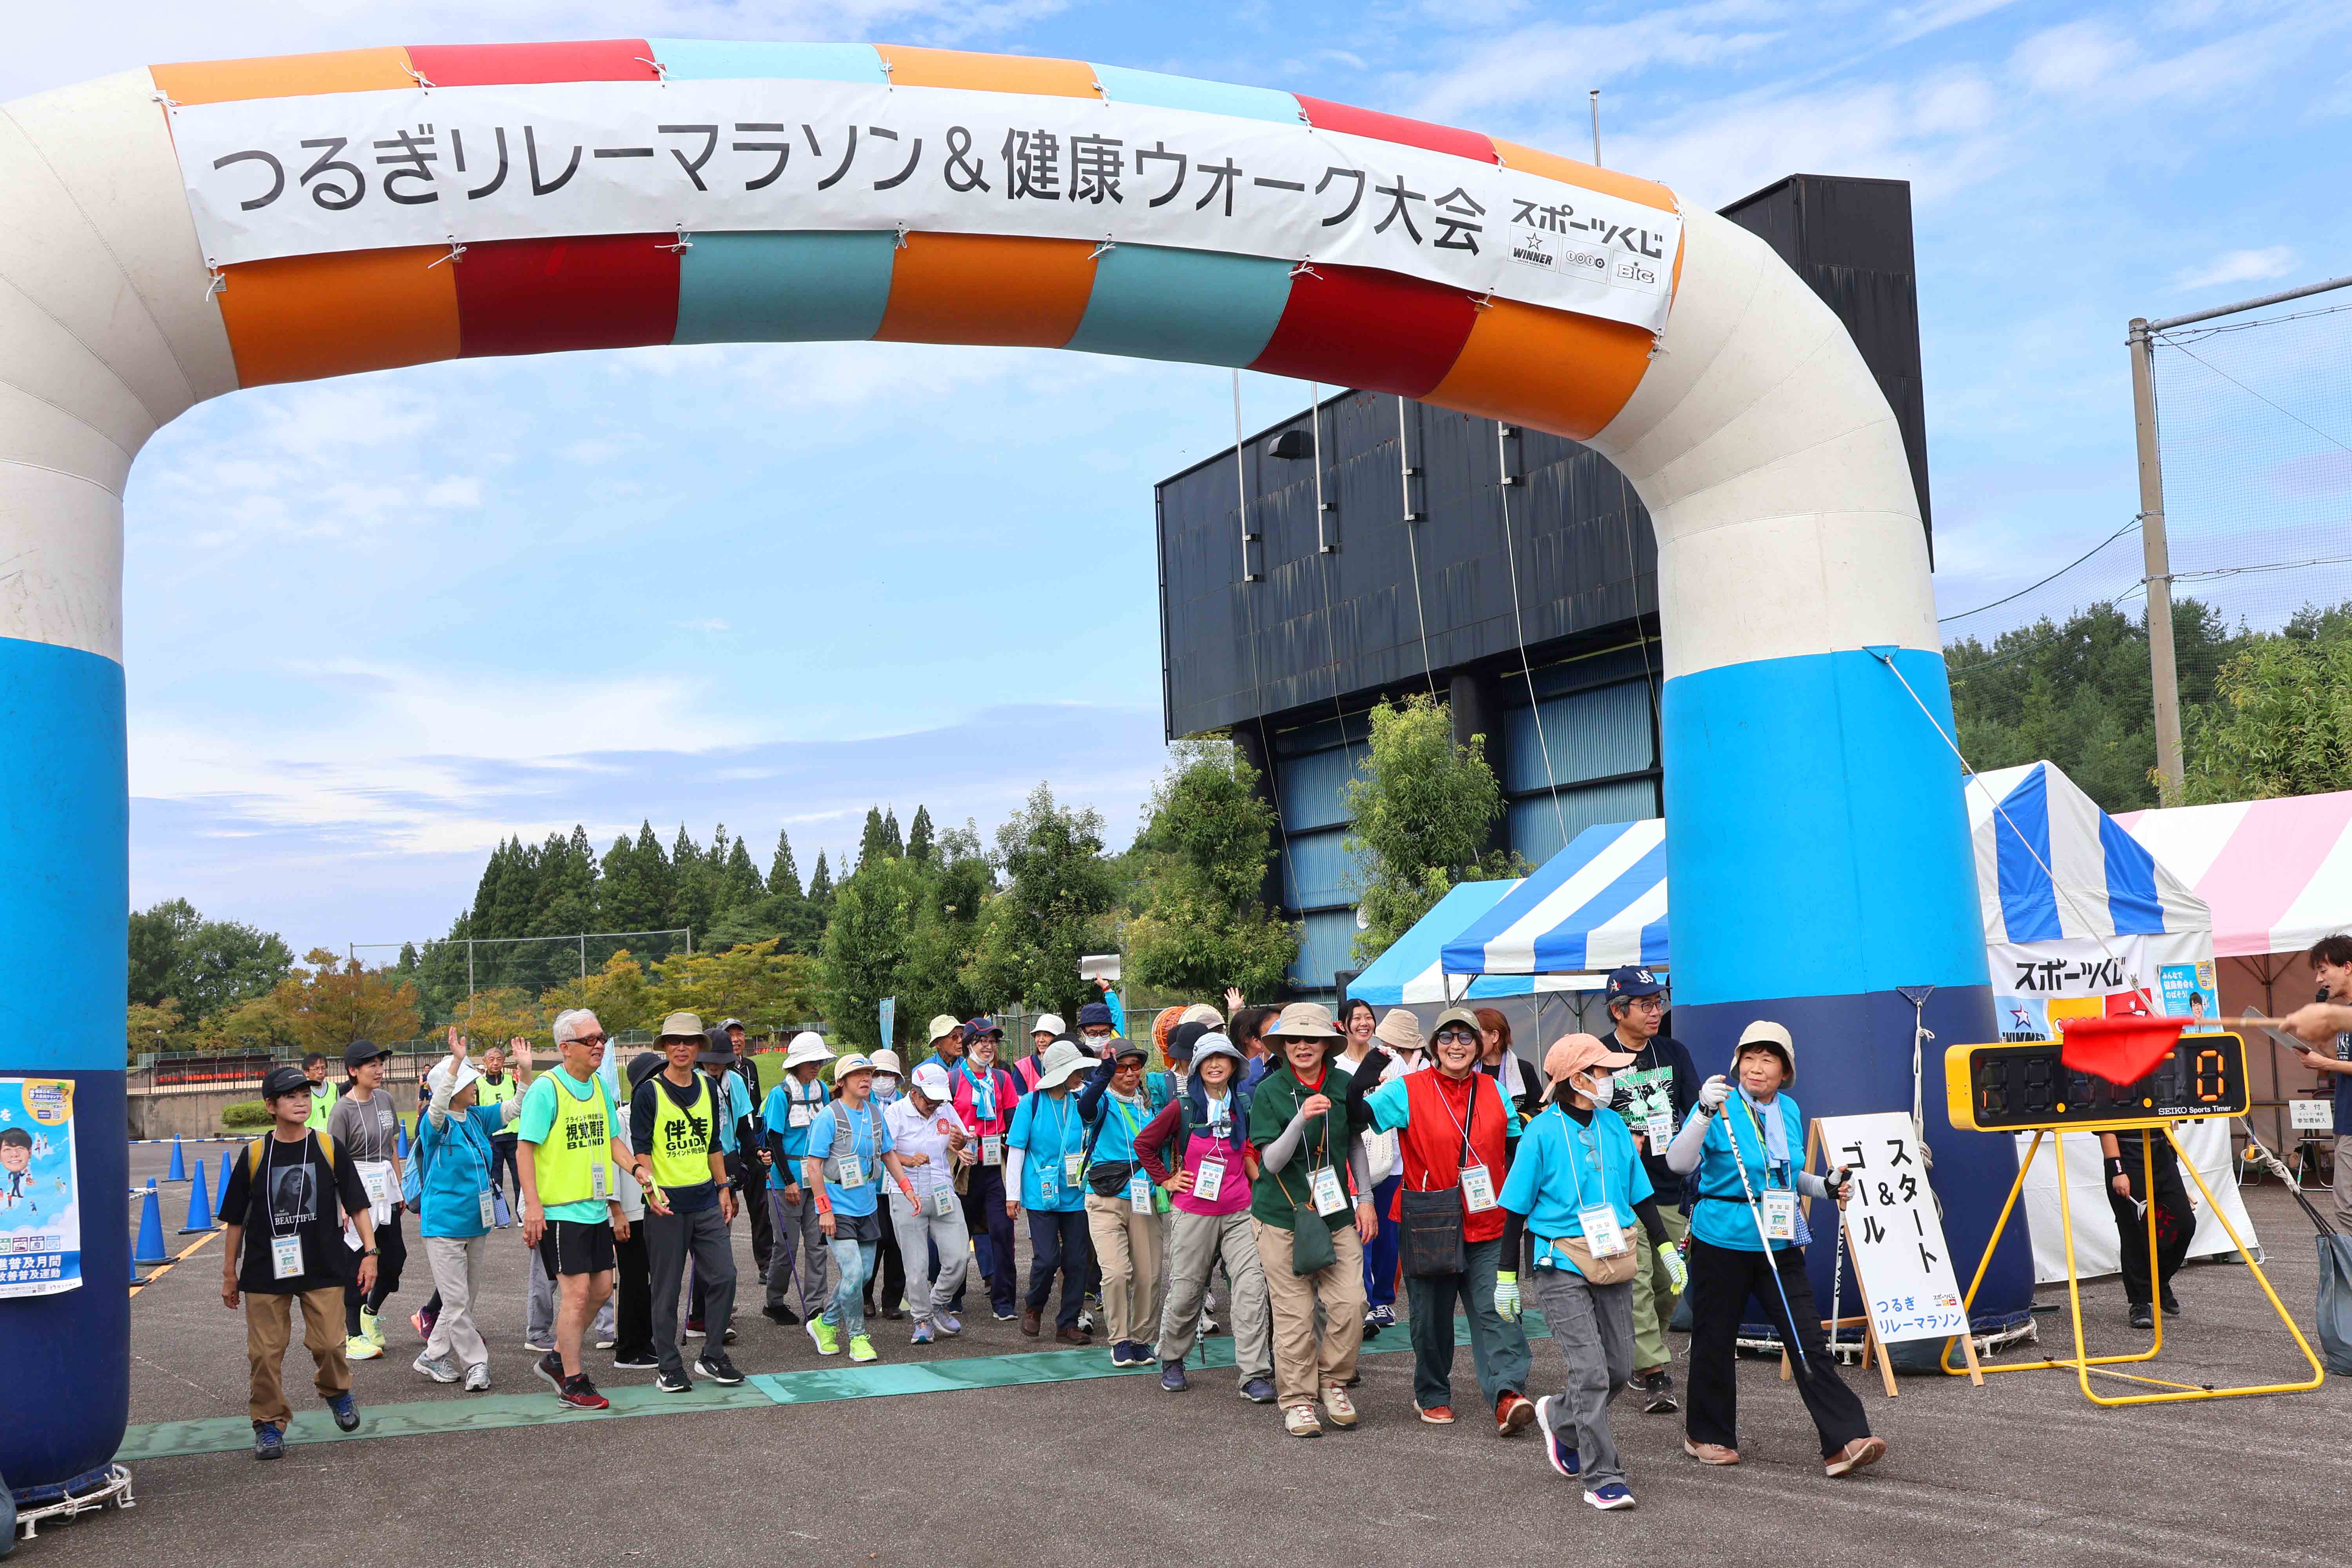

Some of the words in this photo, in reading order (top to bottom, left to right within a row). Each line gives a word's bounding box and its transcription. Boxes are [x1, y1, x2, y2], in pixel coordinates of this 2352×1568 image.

[1510, 198, 1663, 259] スポーツくじ
[1513, 247, 1553, 265] WINNER
[2014, 956, 2126, 991] スポーツくじ
[0, 1108, 11, 1122] を
[319, 1105, 327, 1118] 1
[2158, 1107, 2187, 1115] SEIKO
[566, 1120, 604, 1142] 視覚障害
[567, 1138, 604, 1150] BLIND
[1842, 1140, 1886, 1245] ゴール
[1878, 1182, 1896, 1205] &
[1886, 1139, 1938, 1274] スタート
[275, 1212, 317, 1226] BEAUTIFUL
[1877, 1296, 1915, 1313] つるぎ
[1879, 1314, 1961, 1334] リレーマラソン
